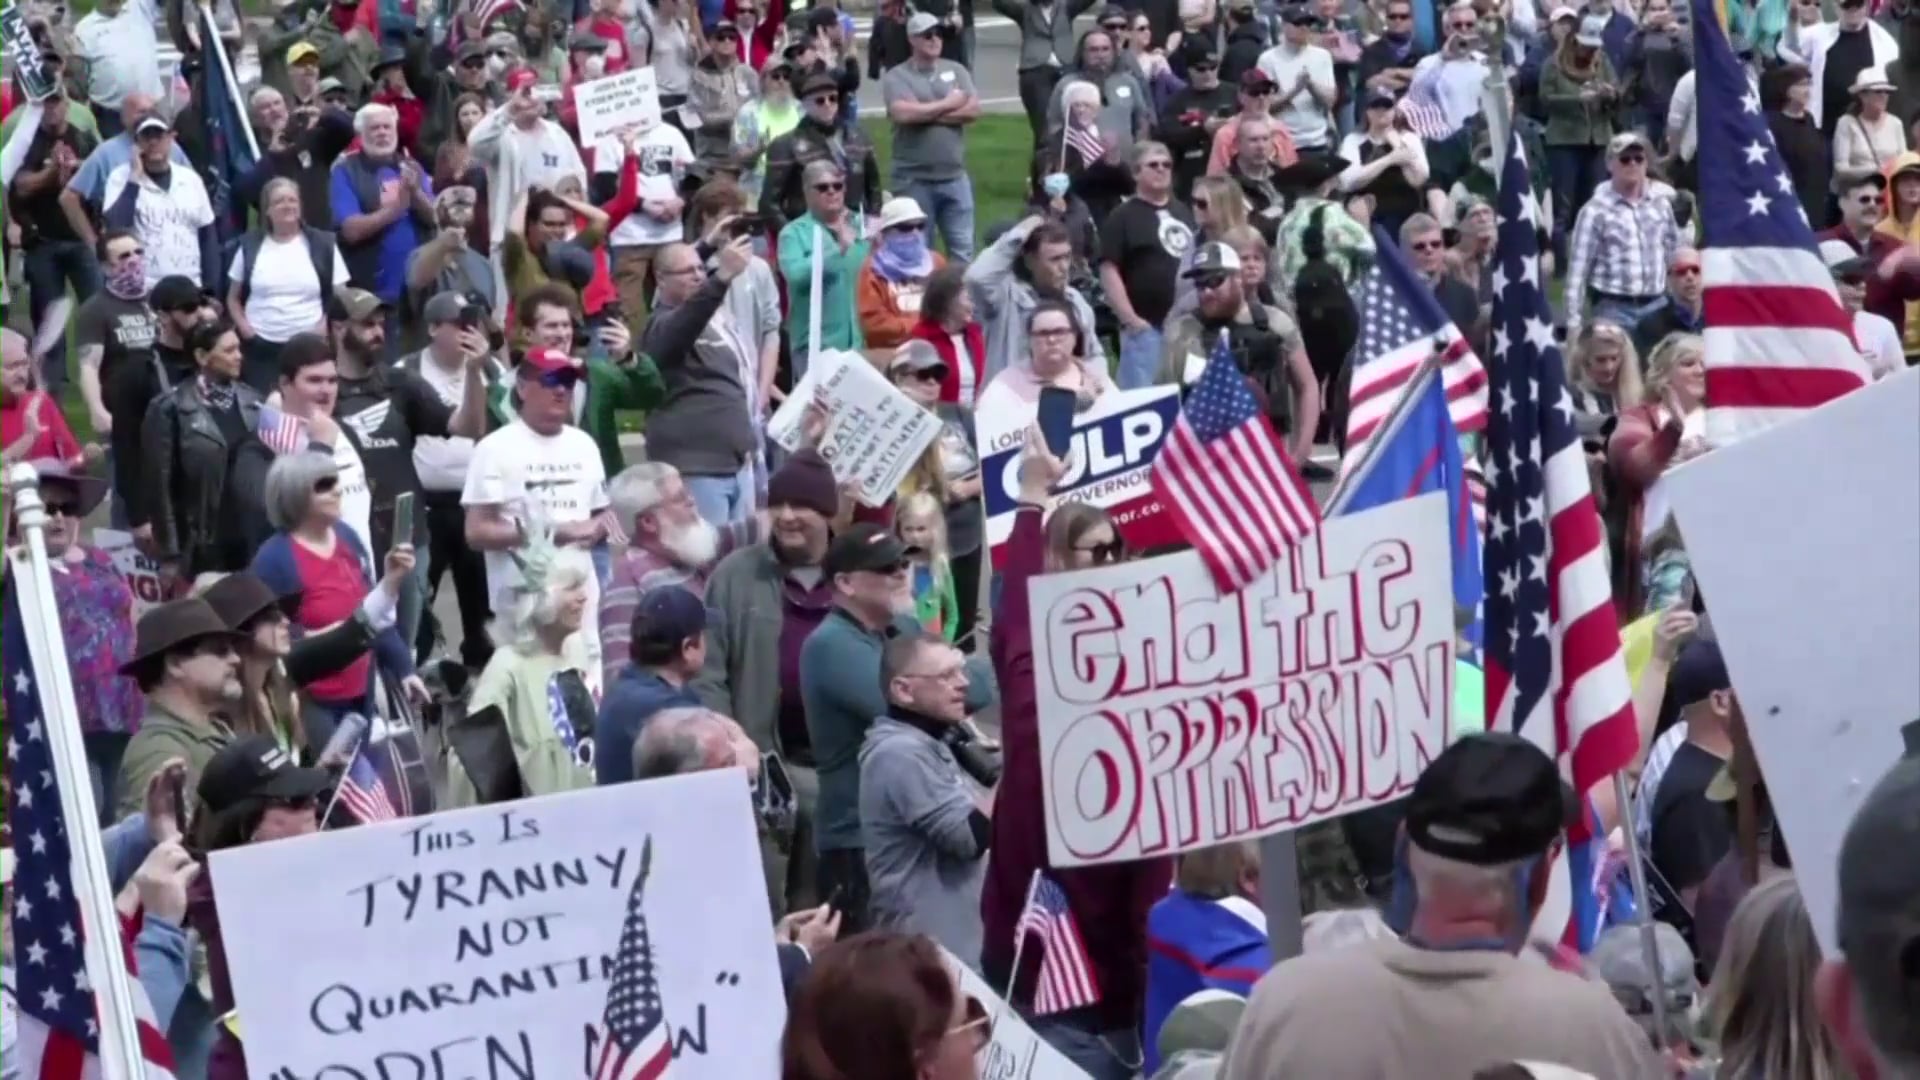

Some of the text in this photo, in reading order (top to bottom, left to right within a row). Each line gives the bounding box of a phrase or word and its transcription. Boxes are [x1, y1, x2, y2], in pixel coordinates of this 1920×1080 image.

[361, 437, 400, 450] NDA
[822, 407, 866, 459] OATH
[1046, 522, 1421, 704] end the
[1050, 641, 1450, 861] OPPRESSION
[347, 846, 628, 928] TYRANNY
[455, 912, 565, 962] NOT
[309, 953, 620, 1036] QUARANTIN
